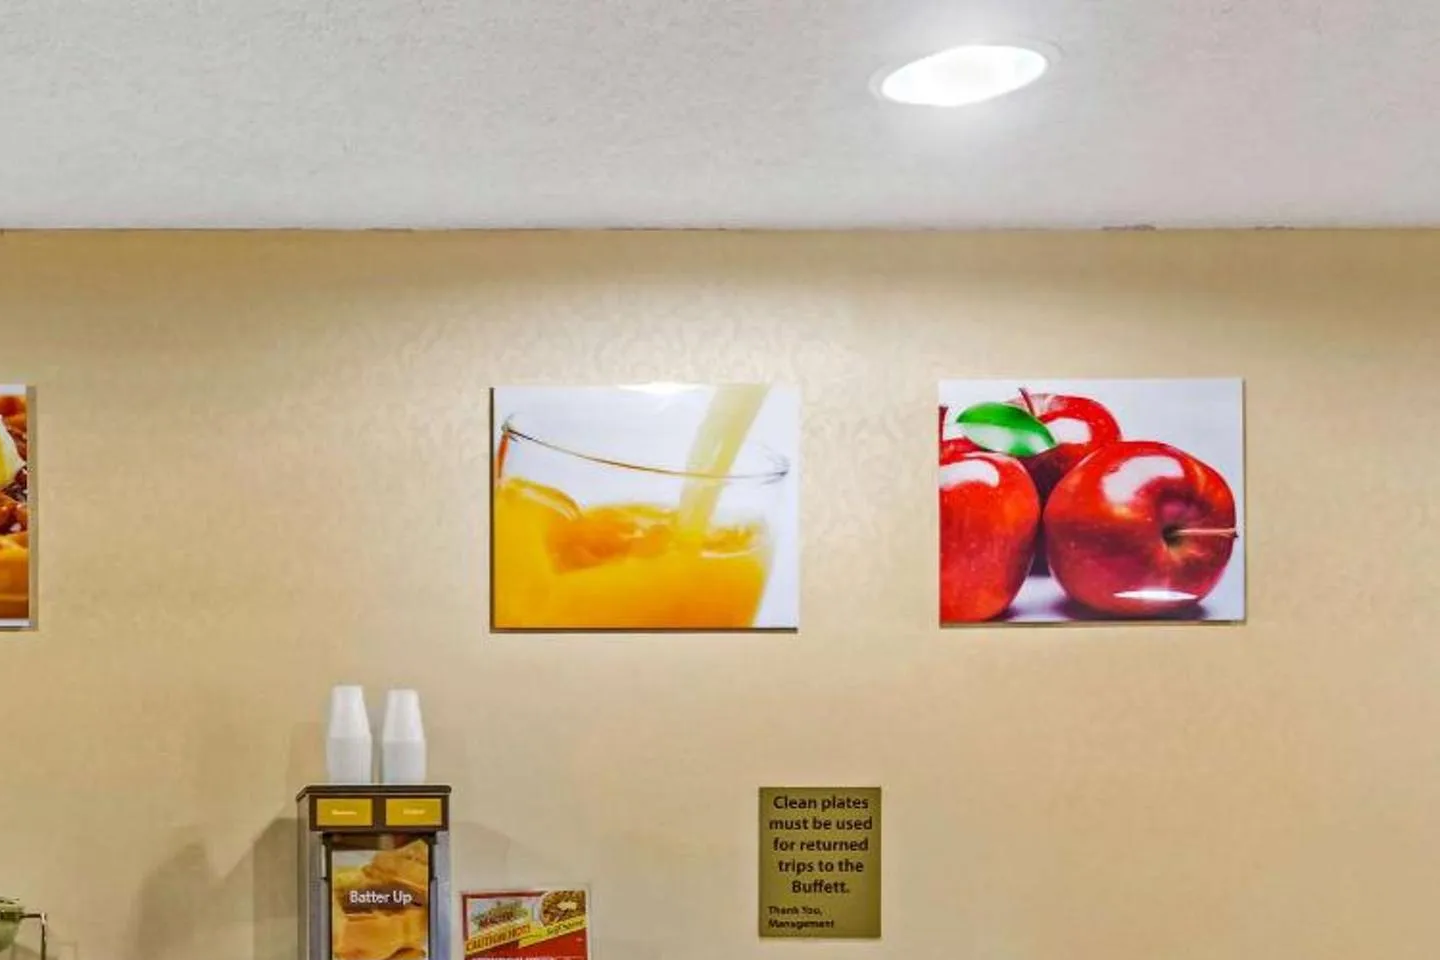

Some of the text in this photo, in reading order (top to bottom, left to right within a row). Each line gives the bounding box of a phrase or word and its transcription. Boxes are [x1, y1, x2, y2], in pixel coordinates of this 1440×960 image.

[772, 795, 869, 812] Clean plates
[768, 816, 873, 830] must be used
[772, 837, 869, 851] for returned
[778, 859, 864, 875] trips to the
[791, 879, 850, 894] Buffett.
[350, 890, 413, 906] Batter Up
[768, 905, 799, 915] Thank
[768, 919, 834, 930] Management
